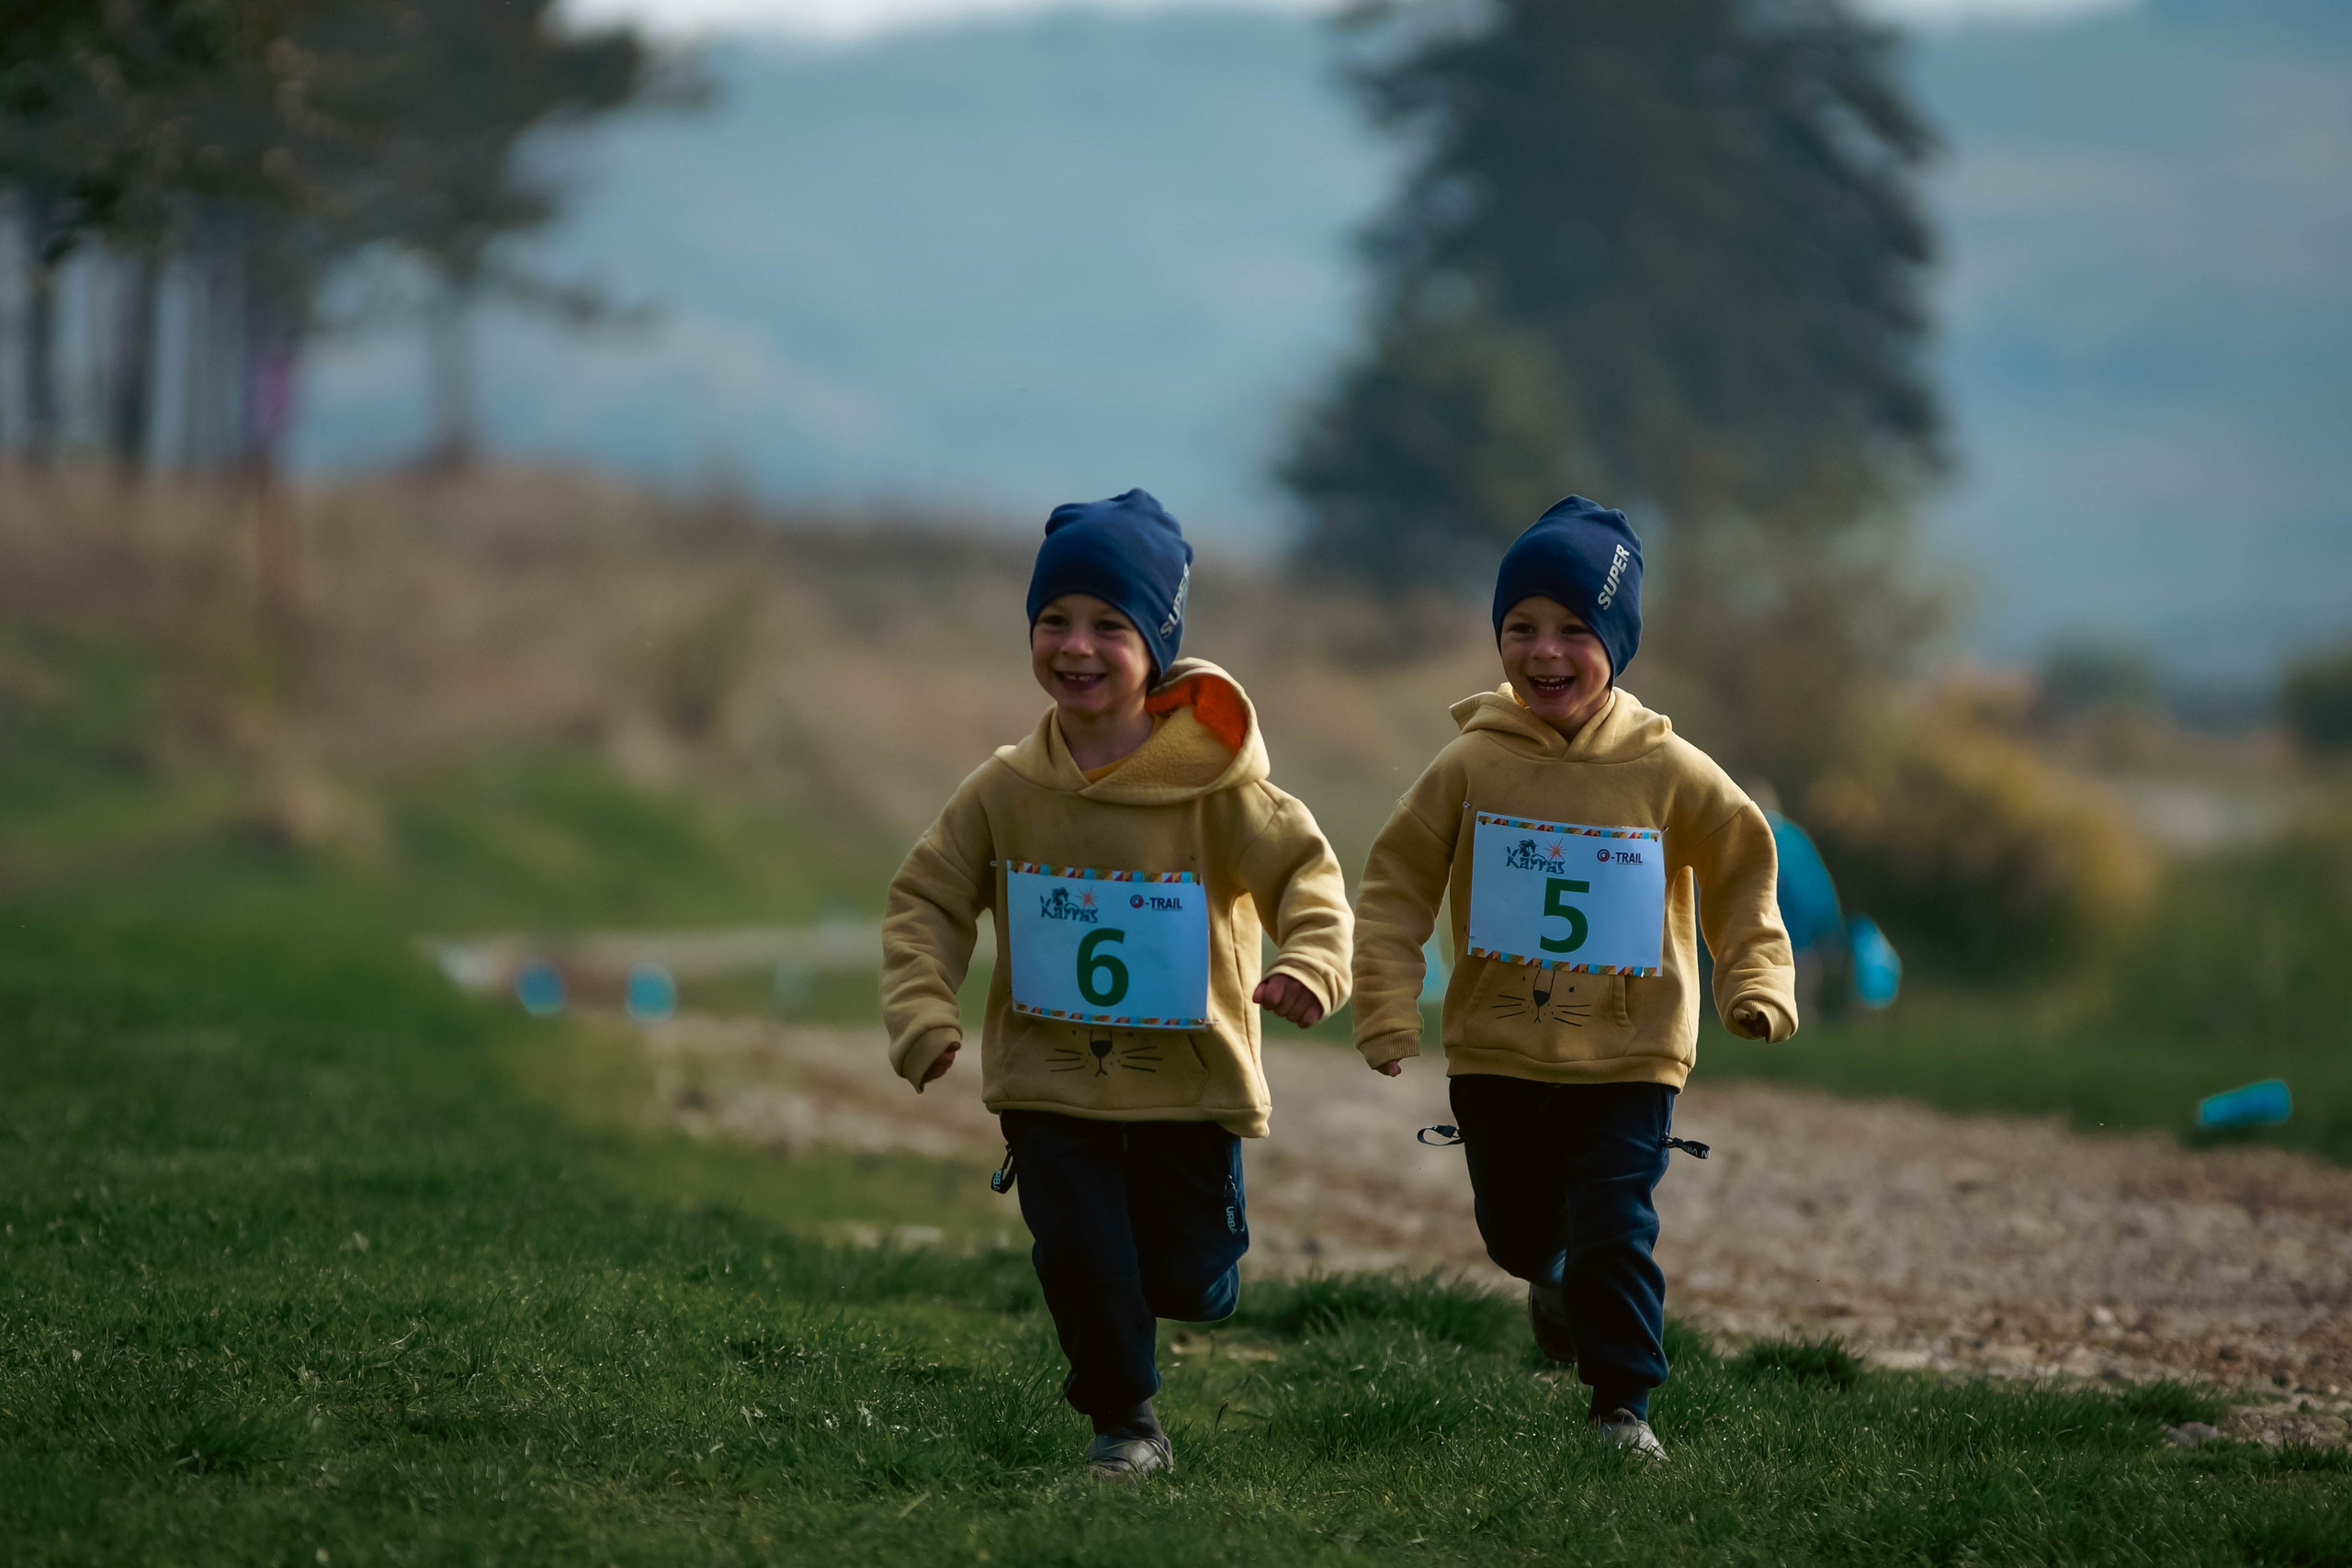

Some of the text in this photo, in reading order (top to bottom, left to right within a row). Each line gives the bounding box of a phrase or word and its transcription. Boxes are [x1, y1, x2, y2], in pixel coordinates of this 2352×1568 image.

[1598, 544, 1630, 610] SUPER
[1540, 877, 1590, 953] 5
[1077, 928, 1129, 1007] 6
